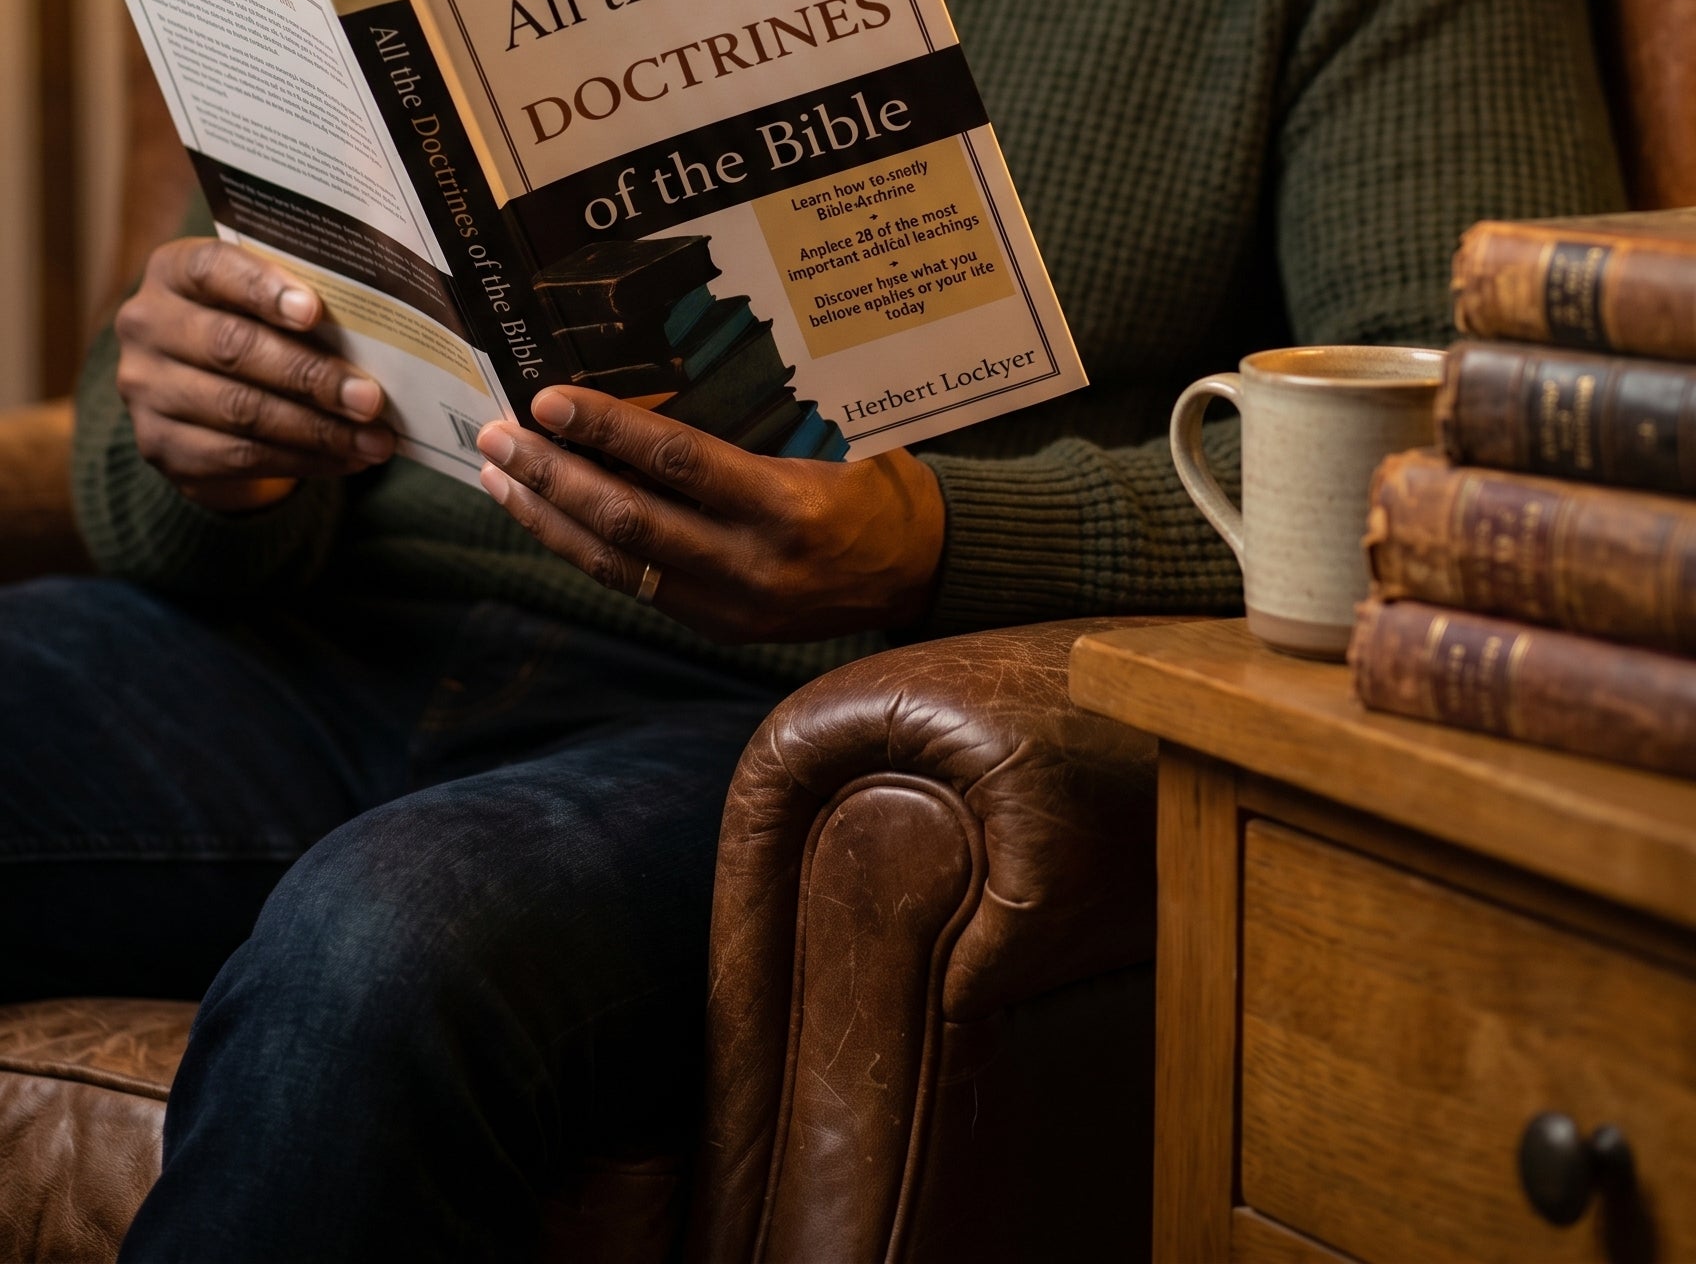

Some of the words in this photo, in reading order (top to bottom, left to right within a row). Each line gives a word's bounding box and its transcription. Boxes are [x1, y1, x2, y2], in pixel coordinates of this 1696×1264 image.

[370, 24, 409, 63] All
[389, 67, 423, 110] the
[411, 113, 478, 238] Doctrines
[584, 167, 642, 231] of
[651, 151, 748, 206] the
[756, 91, 912, 172] Bible
[791, 191, 832, 211] Learn
[833, 180, 865, 198] how
[877, 222, 892, 238] of
[894, 216, 919, 233] the
[922, 203, 959, 224] most
[468, 244, 502, 270] of
[788, 251, 860, 282] important
[481, 282, 511, 314] the
[814, 282, 874, 309] Discover
[911, 259, 948, 279] what
[950, 251, 978, 269] you
[917, 282, 933, 295] or
[935, 271, 968, 292] your
[885, 300, 926, 321] today
[500, 318, 544, 380] Bible
[841, 381, 938, 423] Herbert
[939, 349, 1036, 392] Lockyer
